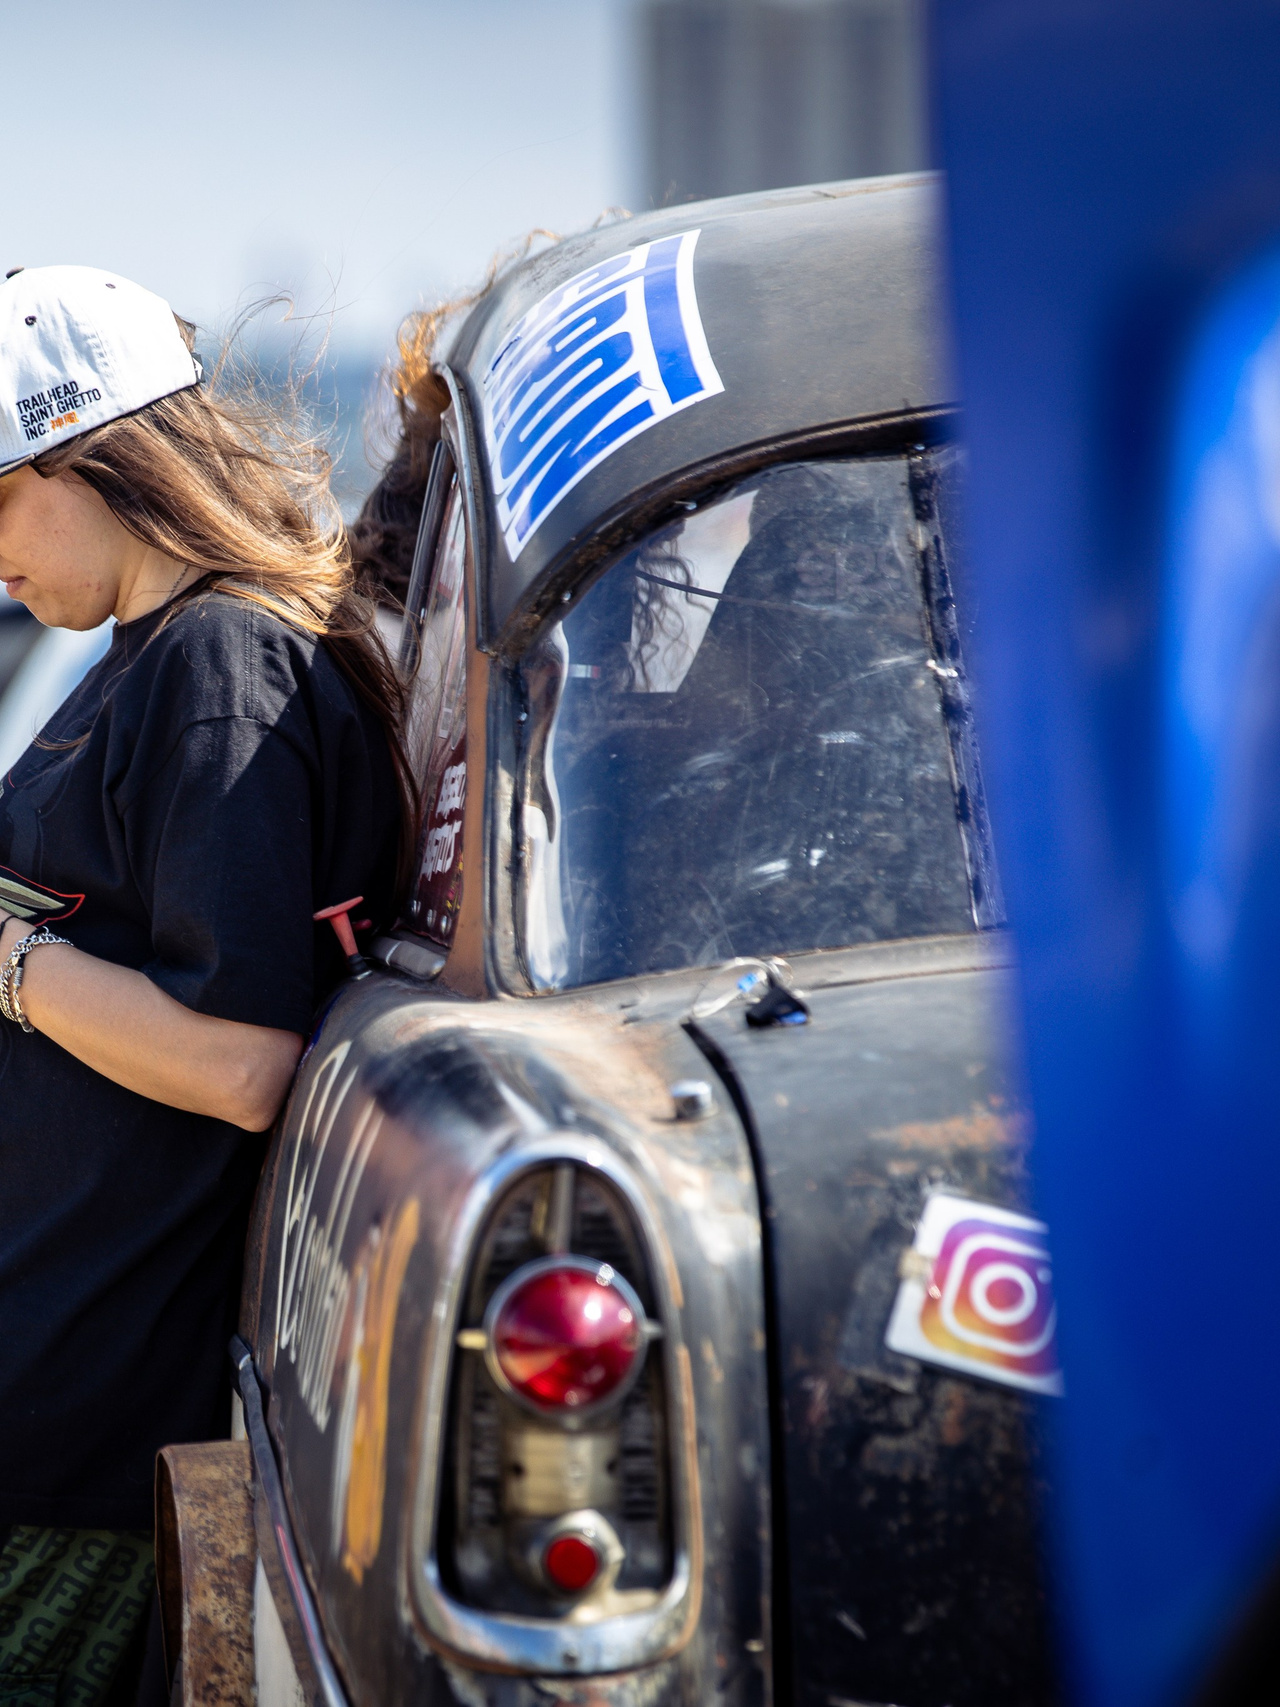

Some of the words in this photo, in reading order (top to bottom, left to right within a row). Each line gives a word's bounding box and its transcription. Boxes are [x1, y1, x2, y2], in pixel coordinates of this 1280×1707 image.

[16, 380, 79, 414] TRAILHEAD
[21, 403, 55, 427] SAINT
[56, 388, 101, 414] GHETTO
[25, 422, 50, 441] INC.
